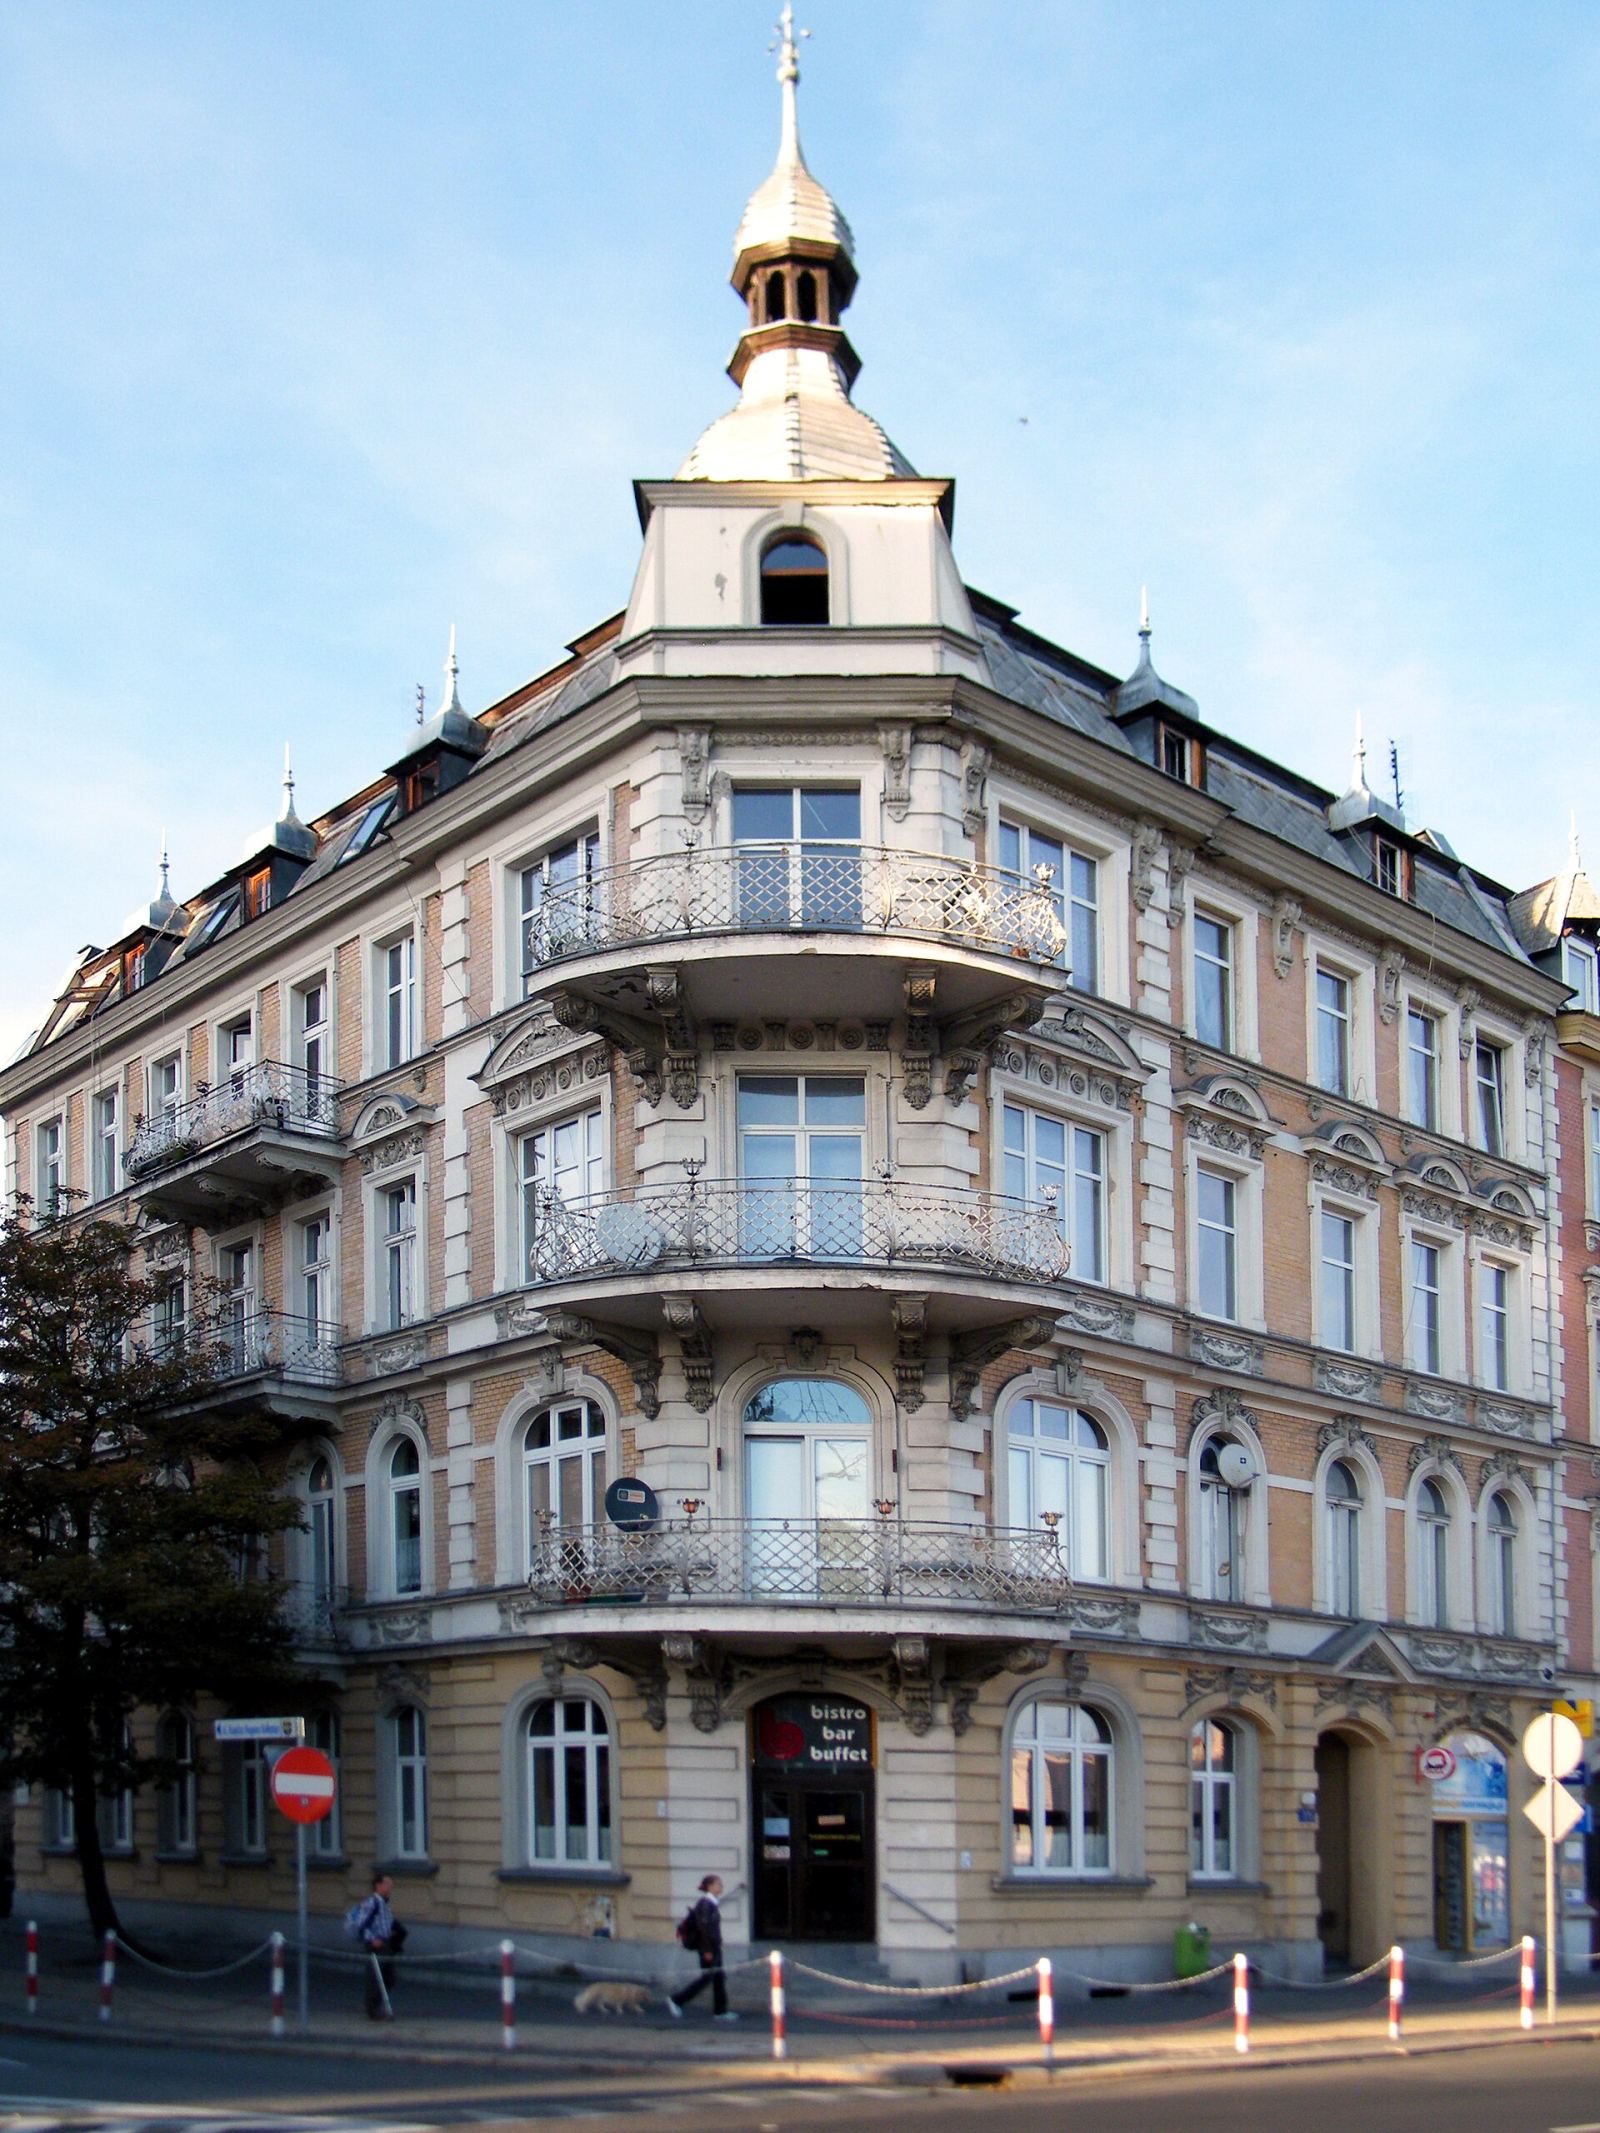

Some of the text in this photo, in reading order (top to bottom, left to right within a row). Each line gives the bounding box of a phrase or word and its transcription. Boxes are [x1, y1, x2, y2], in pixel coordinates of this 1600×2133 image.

[811, 1704, 866, 1719] bistro
[823, 1726, 855, 1740] bar
[810, 1746, 867, 1761] buffet
